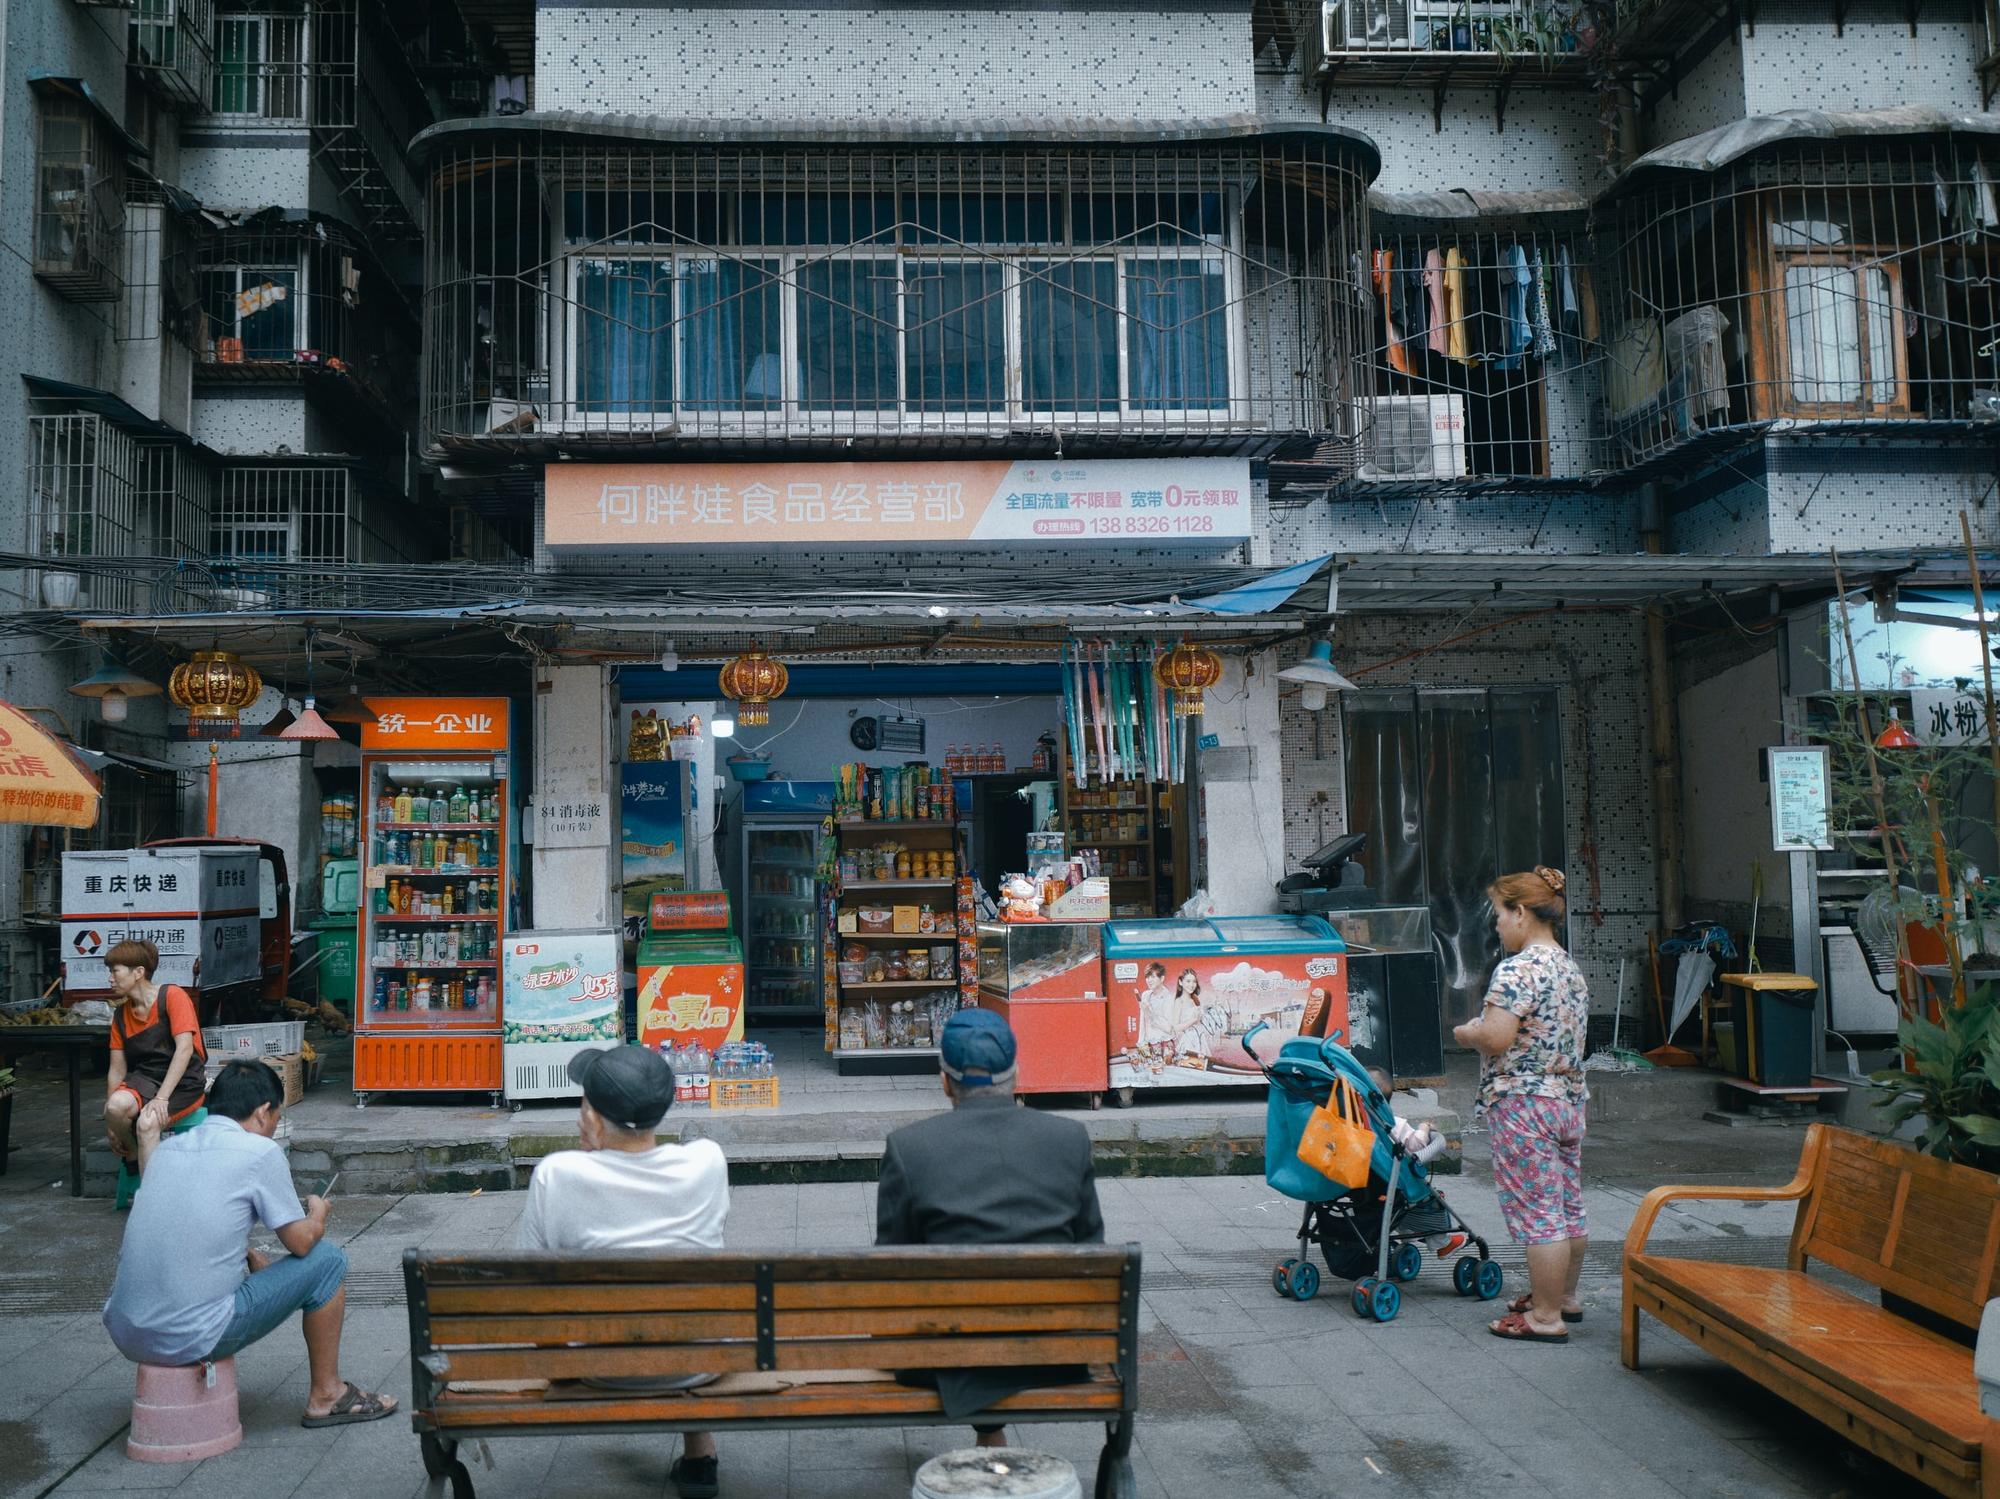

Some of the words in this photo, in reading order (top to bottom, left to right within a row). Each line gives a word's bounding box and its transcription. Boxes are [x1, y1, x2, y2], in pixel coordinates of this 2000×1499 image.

[598, 482, 965, 525] 何胖娃食品经营部
[1005, 491, 1122, 510] 全国流量不限量
[1131, 485, 1239, 508] 宽带0元领取
[1089, 517, 1121, 534] 138
[1125, 516, 1169, 533] 8326
[1174, 515, 1213, 532] 1128
[378, 713, 492, 734] 统一企业
[1199, 735, 1218, 748] 1-13
[2, 789, 85, 811] 释放你的能量
[541, 806, 555, 817] 84
[560, 804, 601, 818] 消毒液
[84, 874, 177, 894] 重庆快递
[107, 928, 185, 944] 百世快递
[158, 944, 185, 953] RESS
[523, 967, 579, 991] 绿豆冰沙
